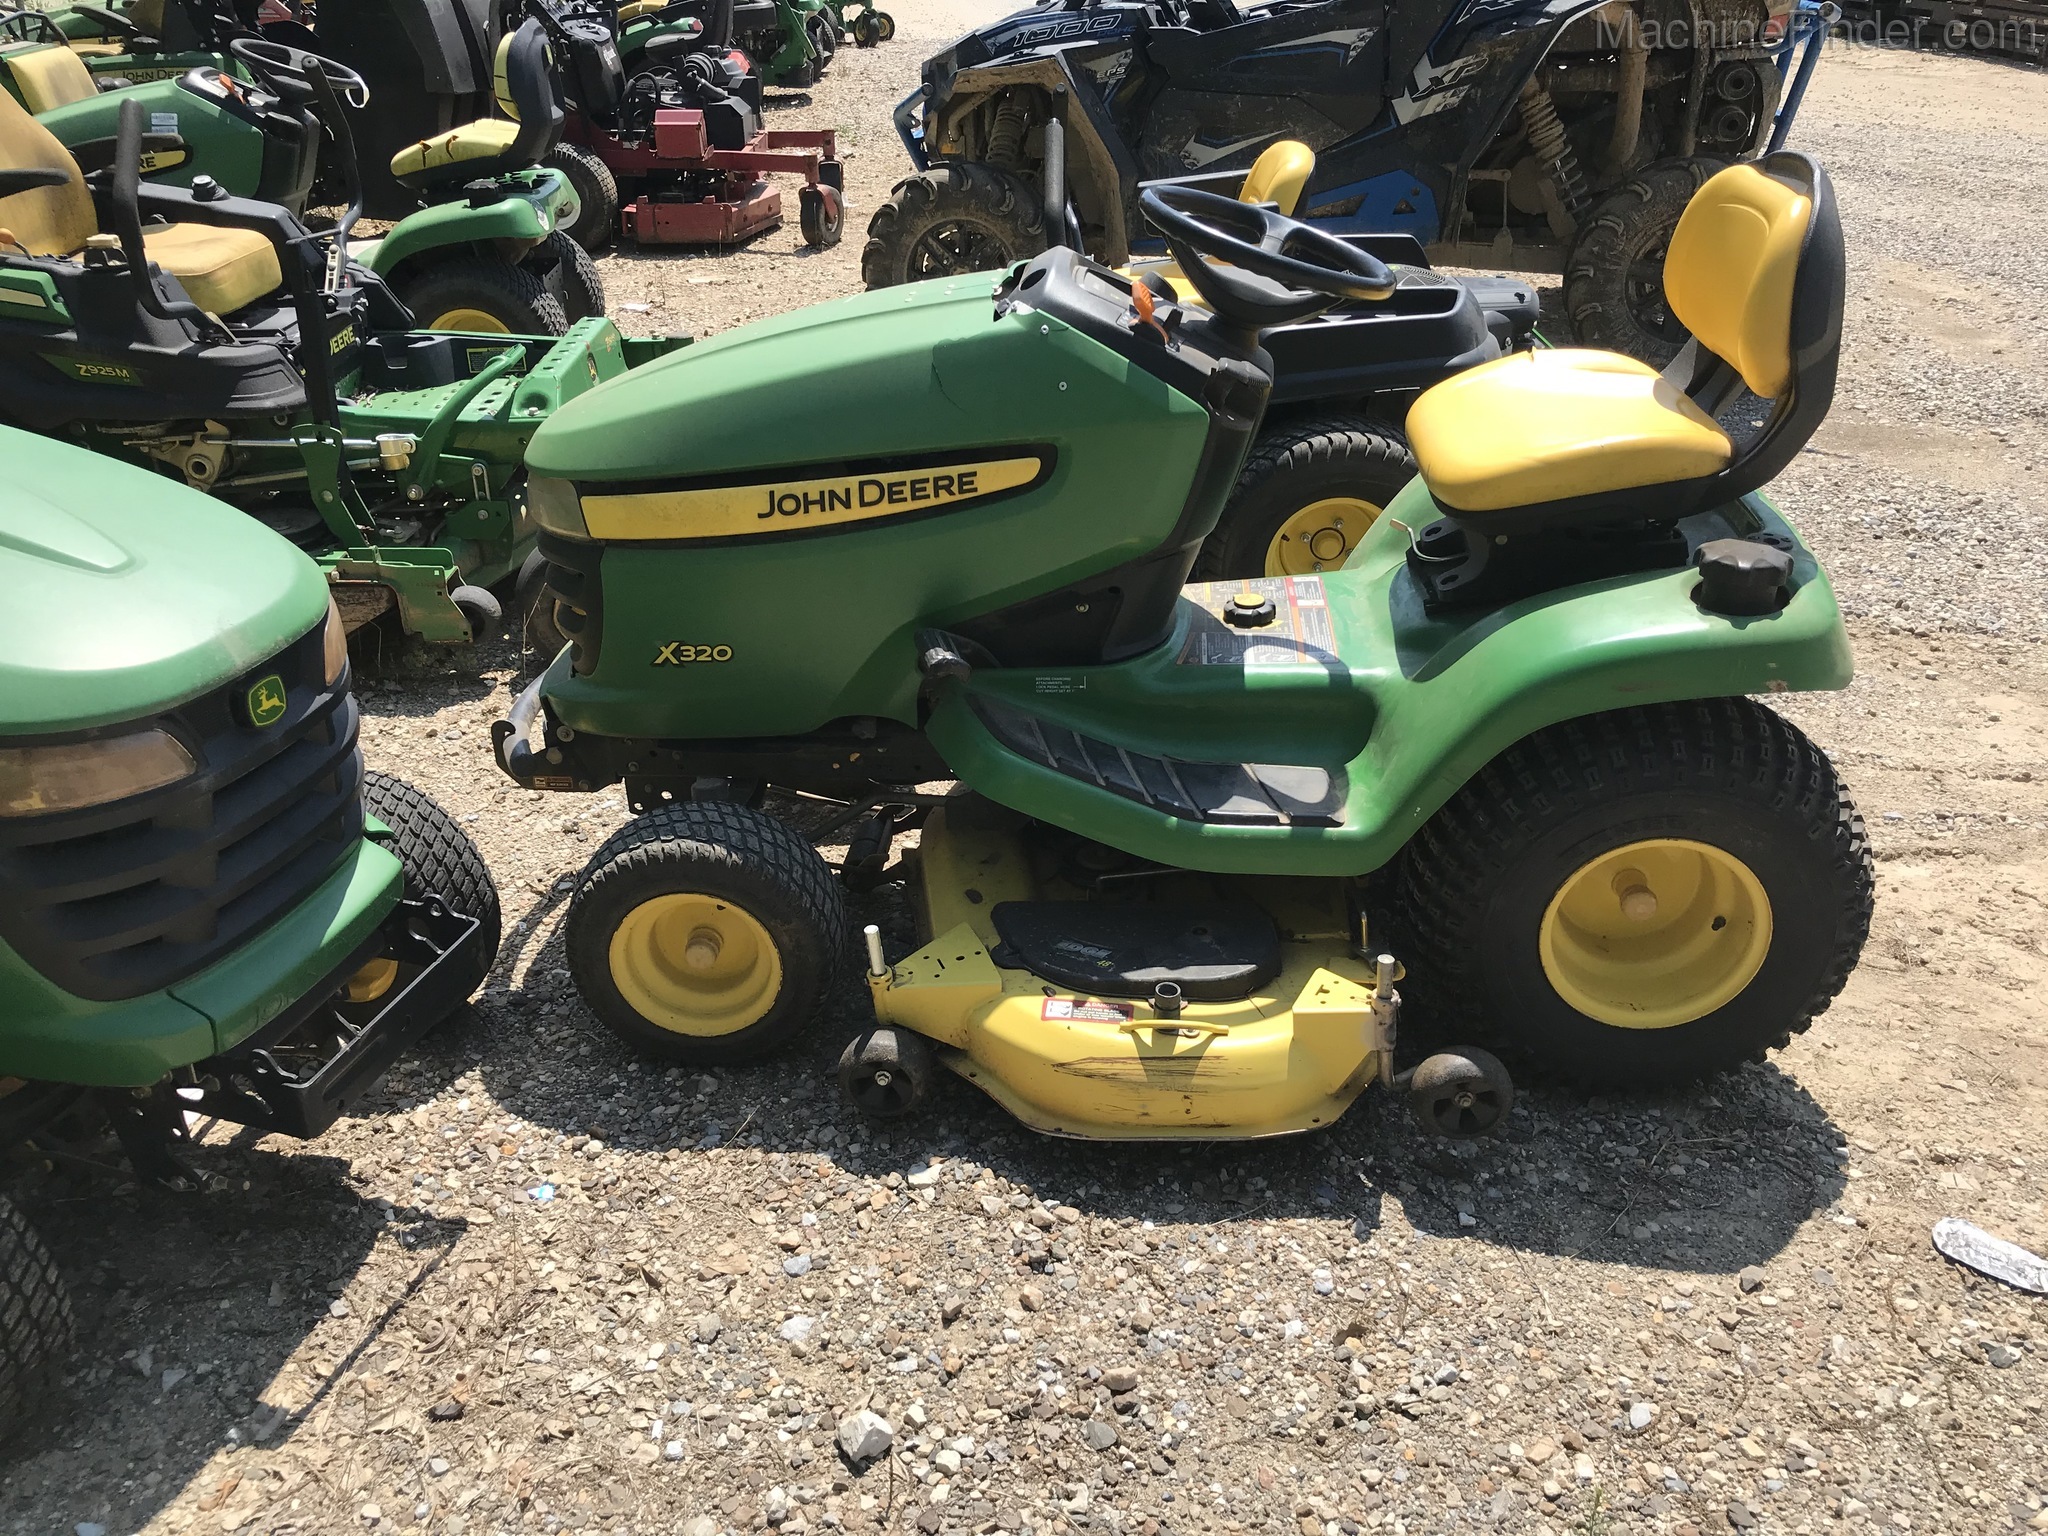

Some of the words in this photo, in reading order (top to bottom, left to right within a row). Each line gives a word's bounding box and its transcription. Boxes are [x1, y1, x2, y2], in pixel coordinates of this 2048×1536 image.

[1013, 14, 1121, 48] 1000
[122, 70, 154, 80] JOHN
[1411, 57, 1489, 99] XP
[330, 325, 355, 356] EERE
[75, 363, 130, 378] Z925M
[757, 487, 852, 519] JOHN
[858, 471, 978, 508] DEERE
[653, 641, 733, 665] X320
